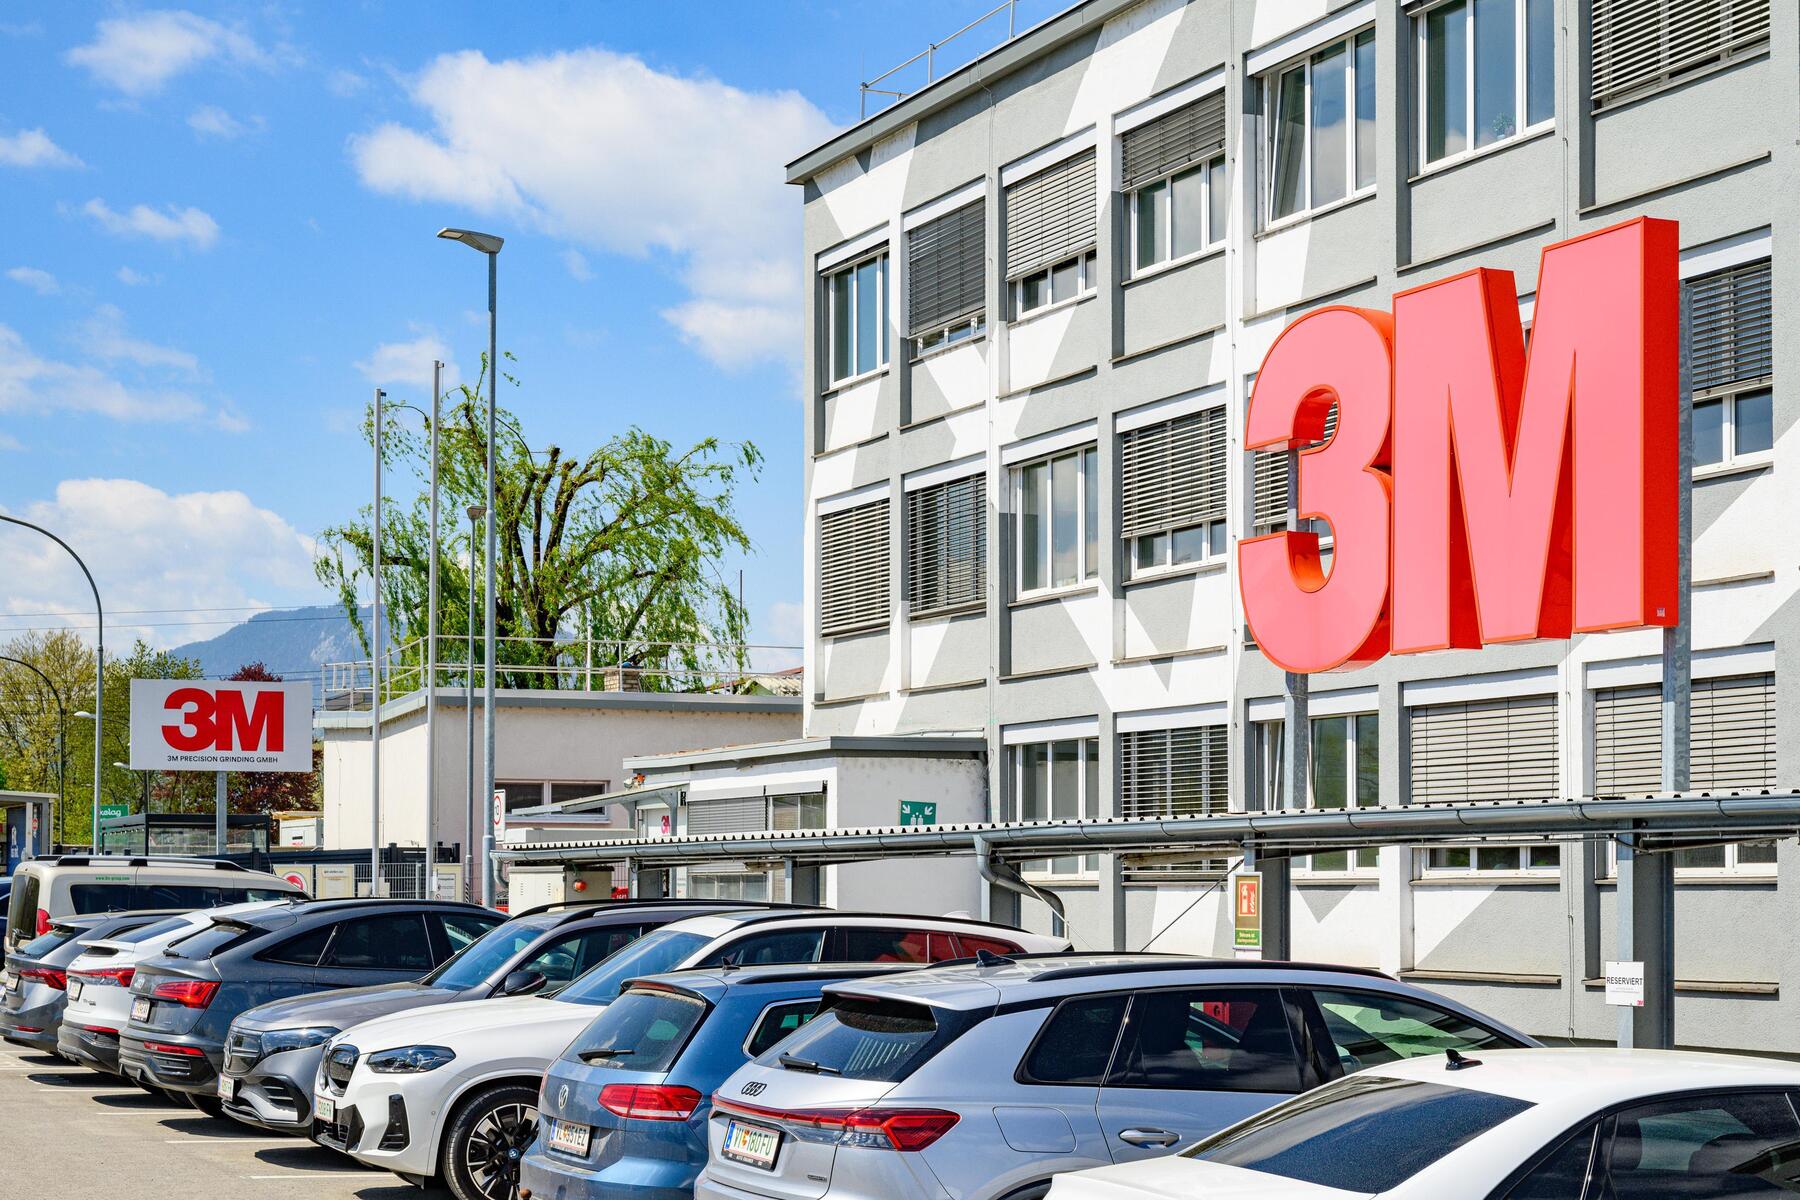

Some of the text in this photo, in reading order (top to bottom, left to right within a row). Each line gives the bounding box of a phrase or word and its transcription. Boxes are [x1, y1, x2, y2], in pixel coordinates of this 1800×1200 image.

[1238, 215, 1679, 674] 3M
[161, 687, 285, 752] 3M
[1606, 977, 1643, 986] RESERVIERT
